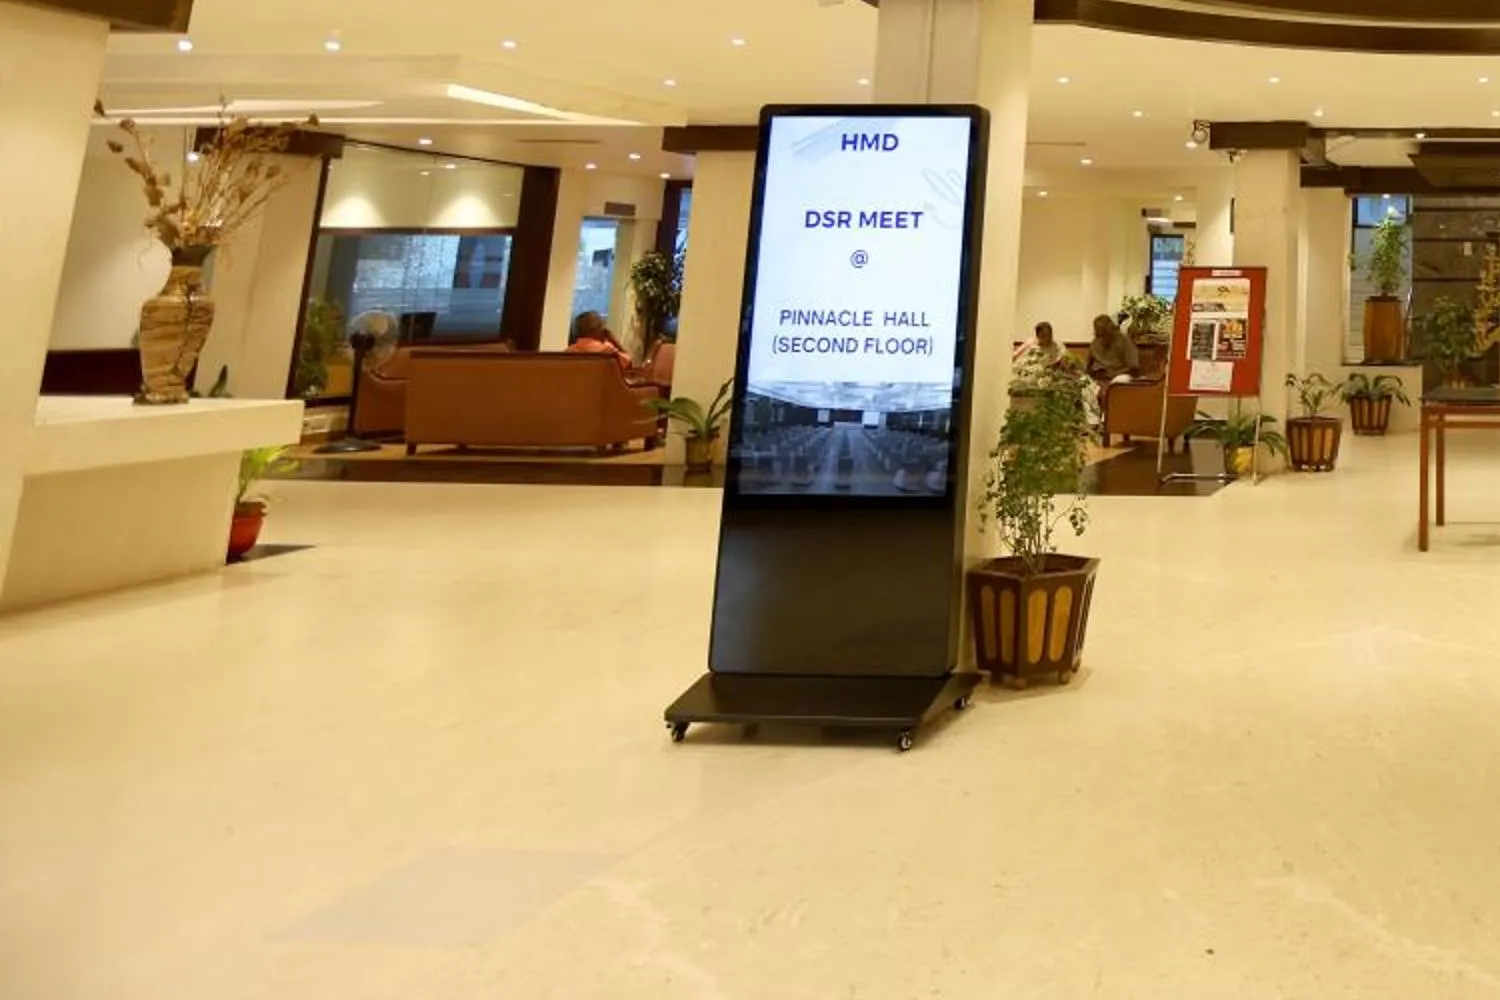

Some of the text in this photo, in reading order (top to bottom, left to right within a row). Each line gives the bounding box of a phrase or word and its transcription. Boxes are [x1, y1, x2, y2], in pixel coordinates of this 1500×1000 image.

[841, 133, 899, 151] HMD
[804, 210, 924, 229] DSR MEET
[850, 249, 869, 269] @
[779, 309, 931, 327] PINNACLE HALL
[772, 334, 933, 356] (SECOND FLOOR)
